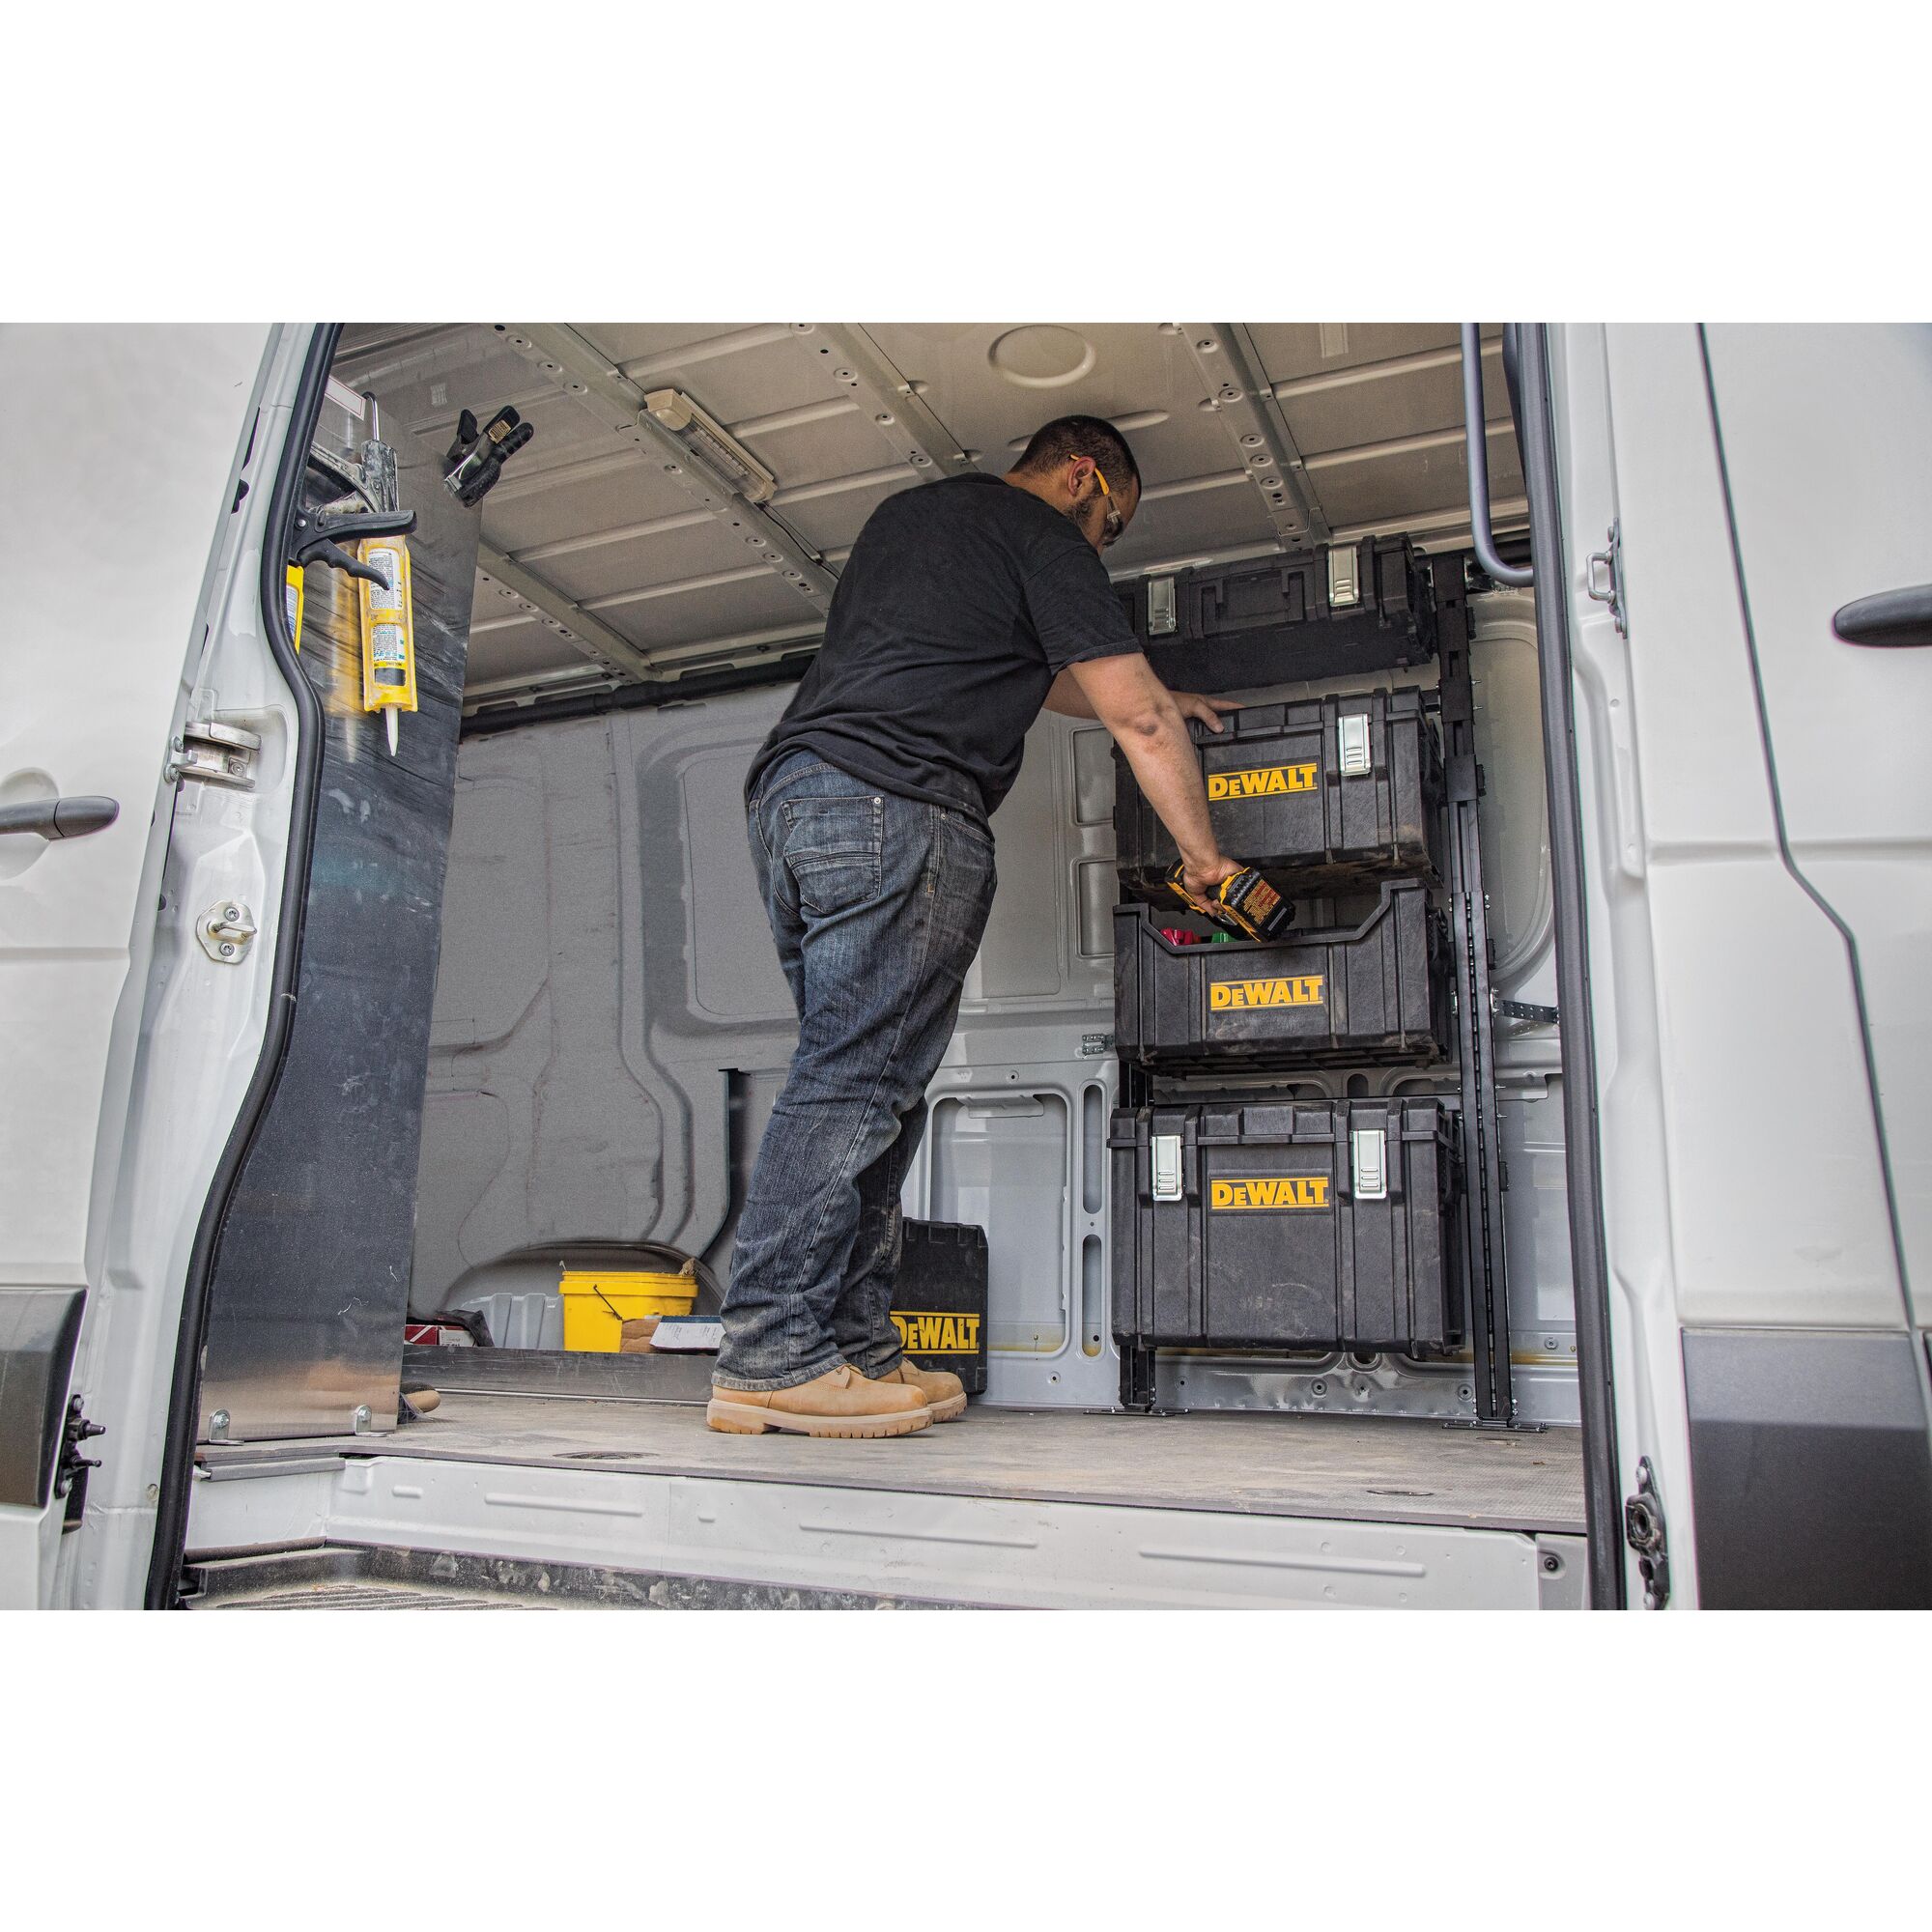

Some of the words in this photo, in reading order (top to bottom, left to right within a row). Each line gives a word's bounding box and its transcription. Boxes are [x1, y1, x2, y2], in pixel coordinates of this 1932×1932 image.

[1208, 766, 1317, 798] DEWALT
[1211, 980, 1322, 1008] DEWALT
[1211, 1180, 1328, 1207] DEWALT
